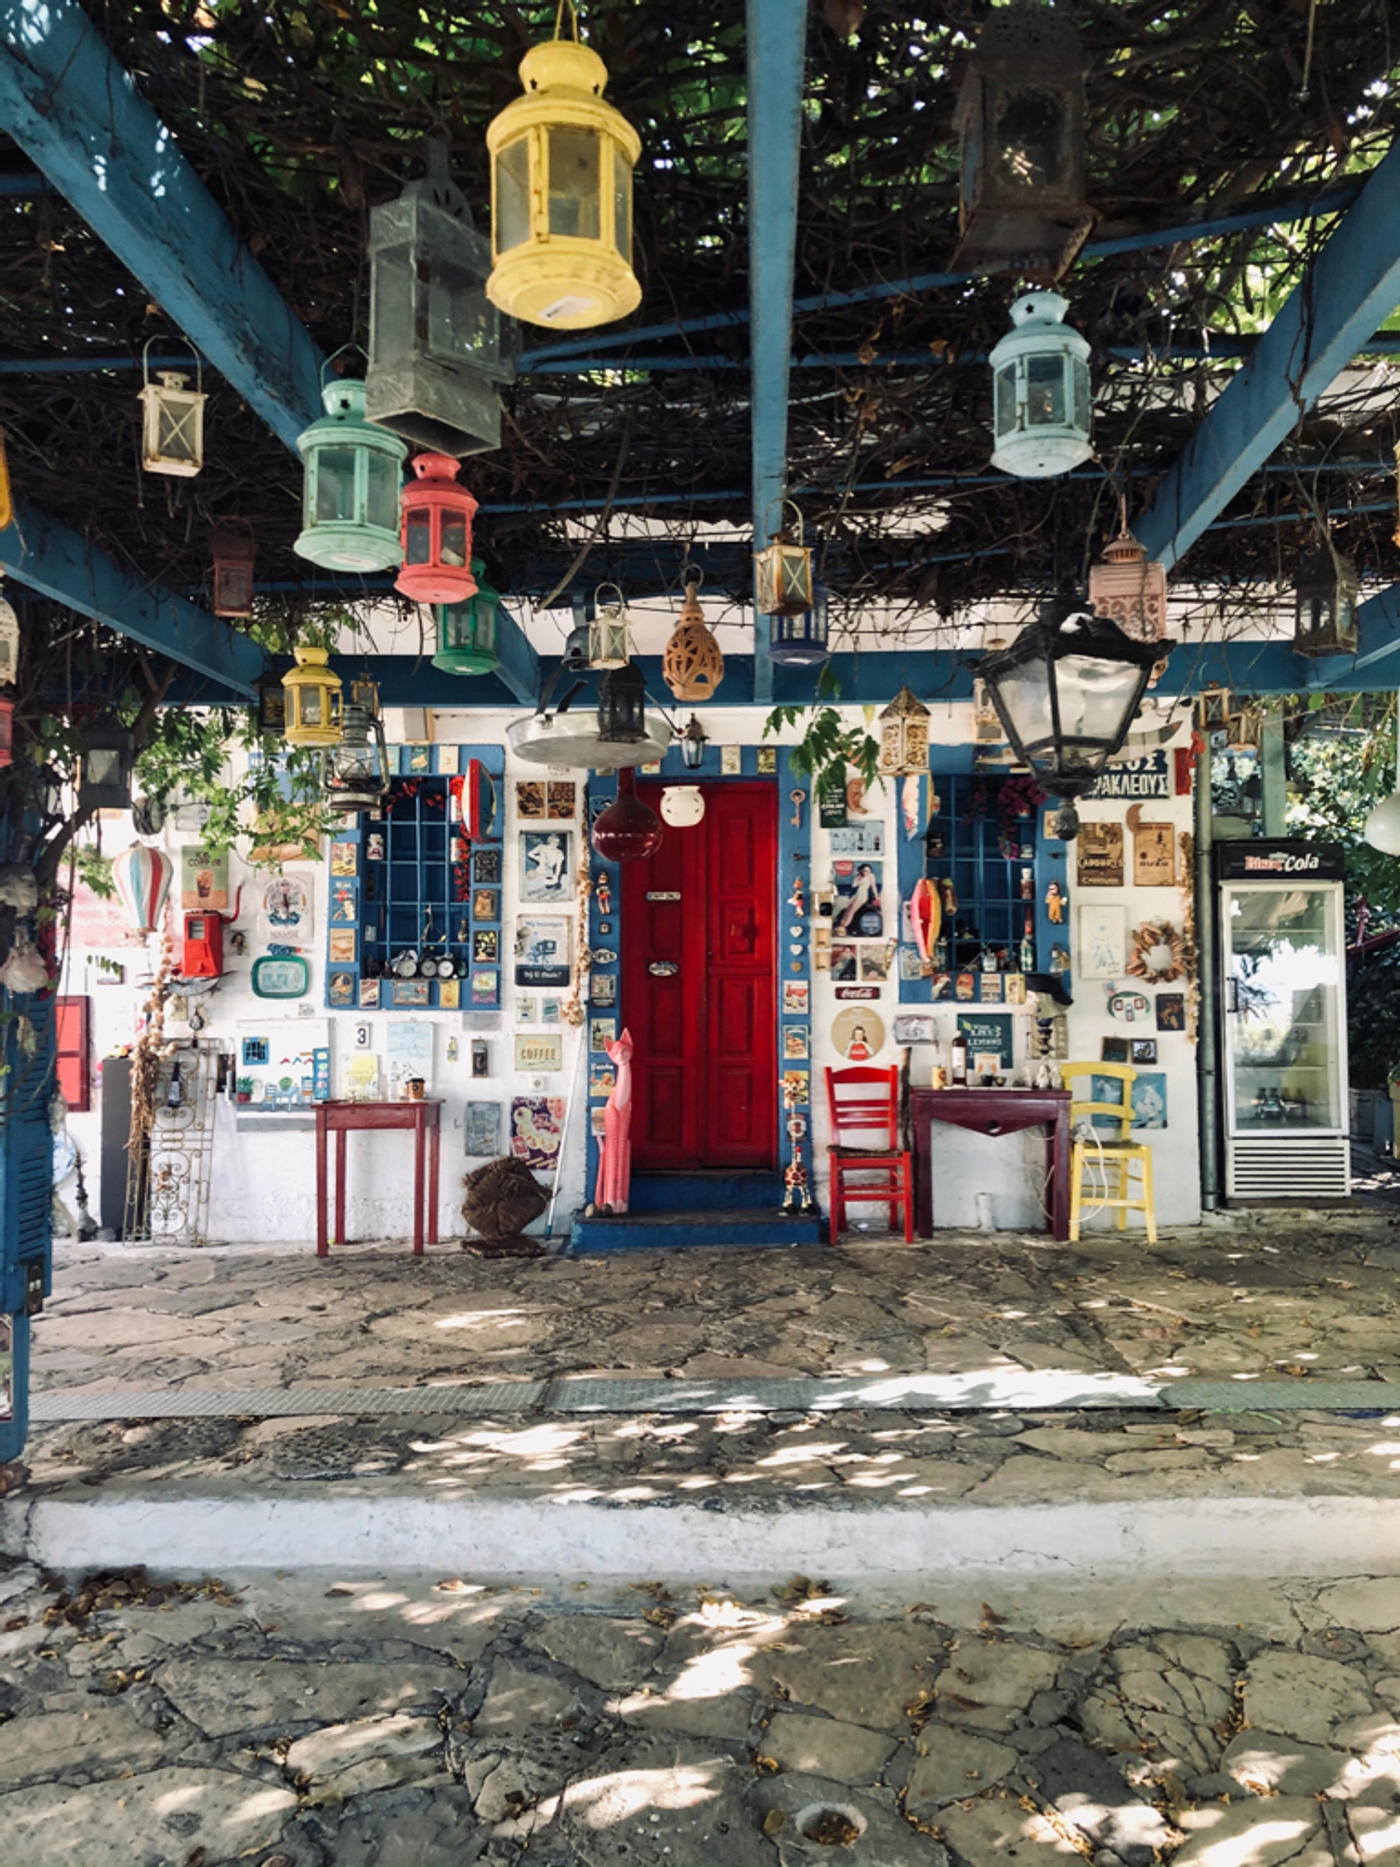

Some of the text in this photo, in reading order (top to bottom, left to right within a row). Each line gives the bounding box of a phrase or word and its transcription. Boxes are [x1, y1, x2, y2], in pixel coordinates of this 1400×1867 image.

[1088, 773, 1167, 795] ΡΑΚΛΕΟΥΣ
[1284, 853, 1320, 872] Cola
[357, 1027, 366, 1044] 3
[521, 1048, 556, 1060] COFFEE
